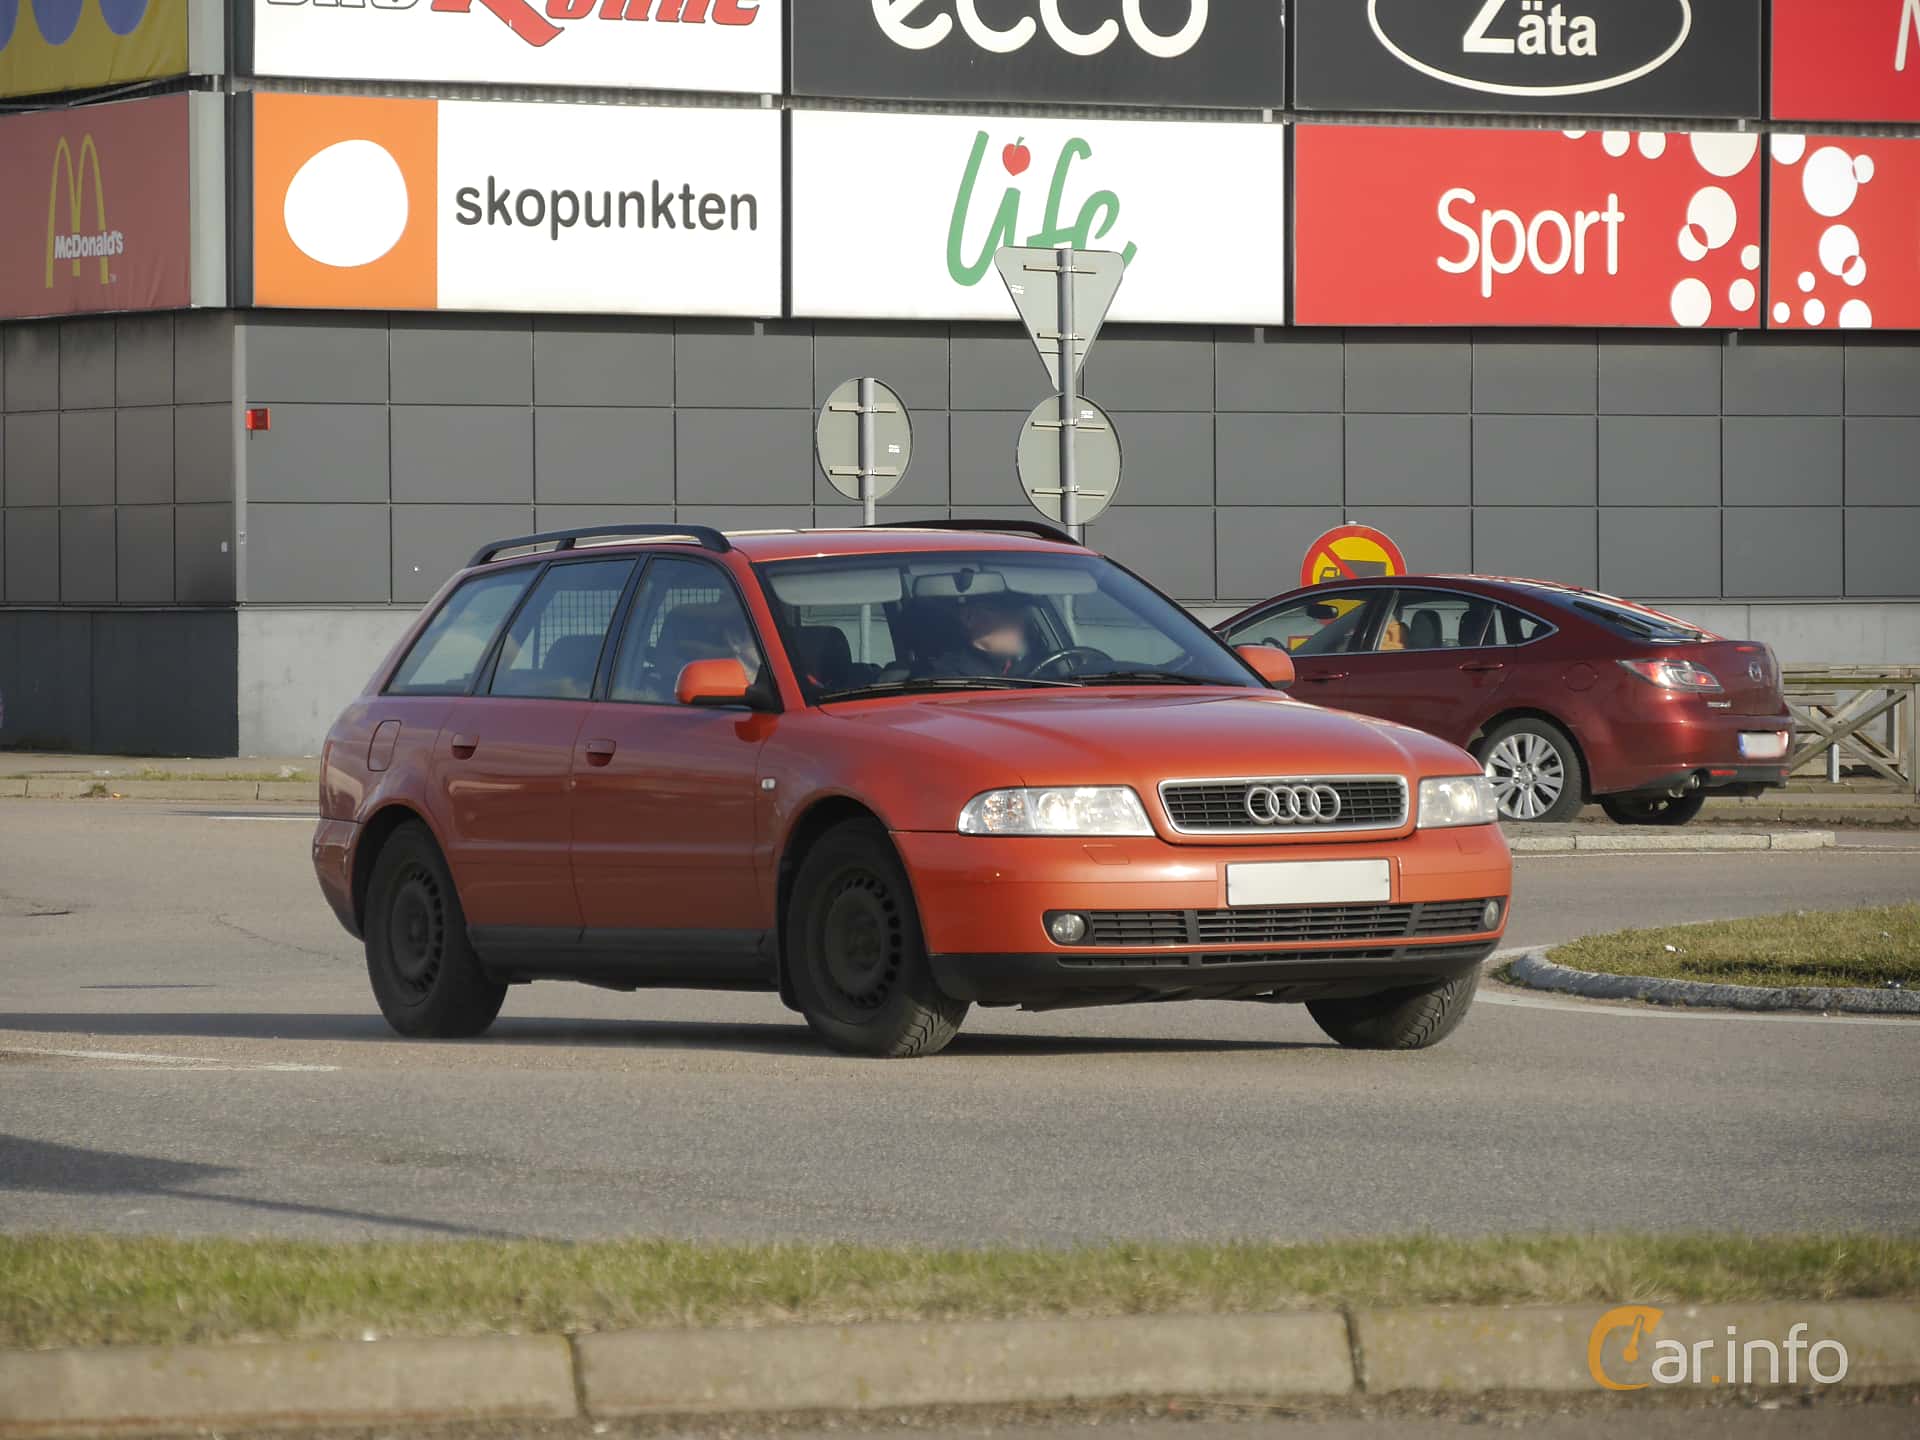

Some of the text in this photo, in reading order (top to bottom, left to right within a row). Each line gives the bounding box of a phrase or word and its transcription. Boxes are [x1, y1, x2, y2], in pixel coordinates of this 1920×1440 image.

[1462, 0, 1598, 56] Zäta
[455, 175, 758, 241] skopunkten
[54, 230, 124, 260] McDonald's
[1436, 187, 1625, 299] Sport
